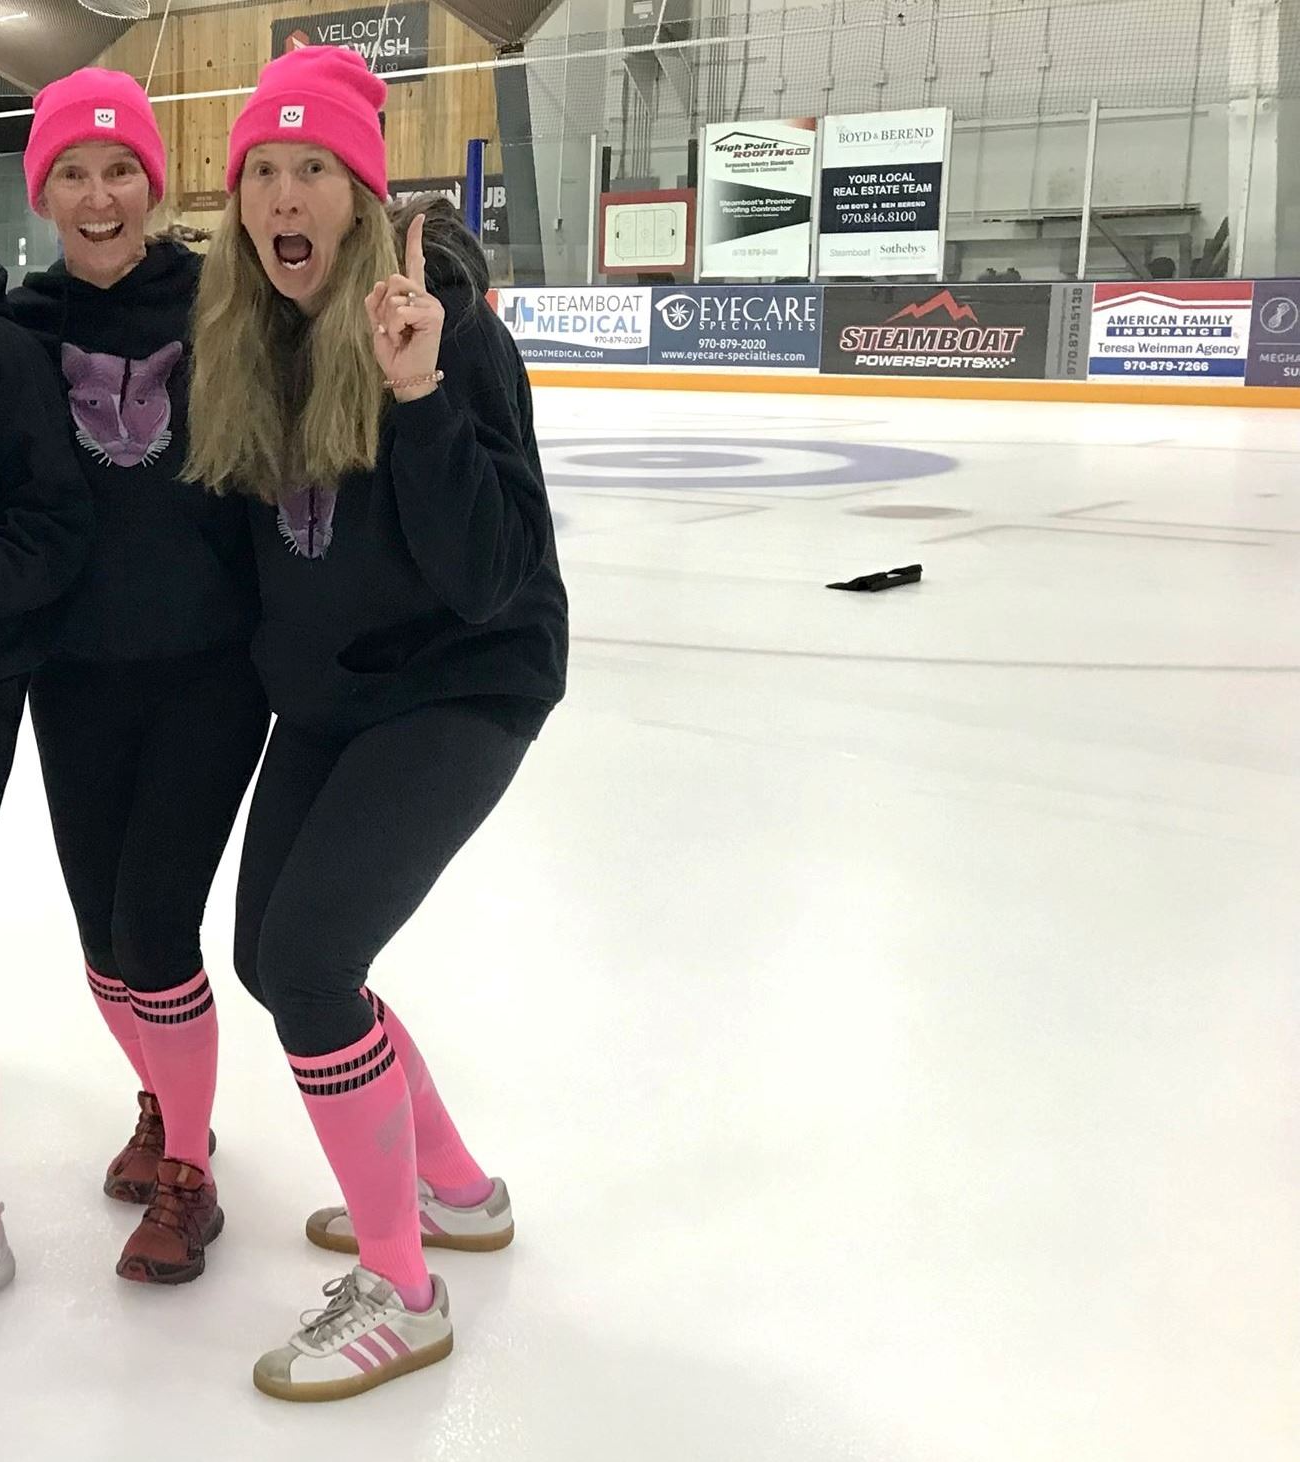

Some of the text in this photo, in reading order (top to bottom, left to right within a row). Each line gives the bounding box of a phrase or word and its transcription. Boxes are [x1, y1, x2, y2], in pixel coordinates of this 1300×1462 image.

[317, 16, 406, 43] VELOCITY
[838, 131, 872, 143] BOYD
[881, 127, 934, 141] BEREND
[715, 142, 779, 152] High Point
[733, 148, 795, 158] ROOFING
[848, 172, 915, 184] YOUR LOCAL
[833, 183, 932, 197] REAL ESTATE TEAM
[841, 210, 917, 224] 970.846.8100
[537, 295, 643, 312] STEAMBOAT
[700, 296, 817, 322] EYECARE
[537, 315, 642, 334] MEDICAL
[699, 321, 816, 331] SPECIALTIES
[1107, 315, 1233, 326] AMERICAN FAMILY
[1115, 327, 1222, 336] INSURANCE
[594, 335, 642, 344] 970-879-0203
[698, 339, 767, 350] 970-879-2020
[839, 326, 1024, 352] STEAMBOAT
[1098, 342, 1241, 356] Teresa Weinman Agency
[661, 350, 806, 362] www.eyecare-specialties.com
[855, 354, 985, 369] POWERSPORTS
[1123, 360, 1209, 372] 970-879-7266
